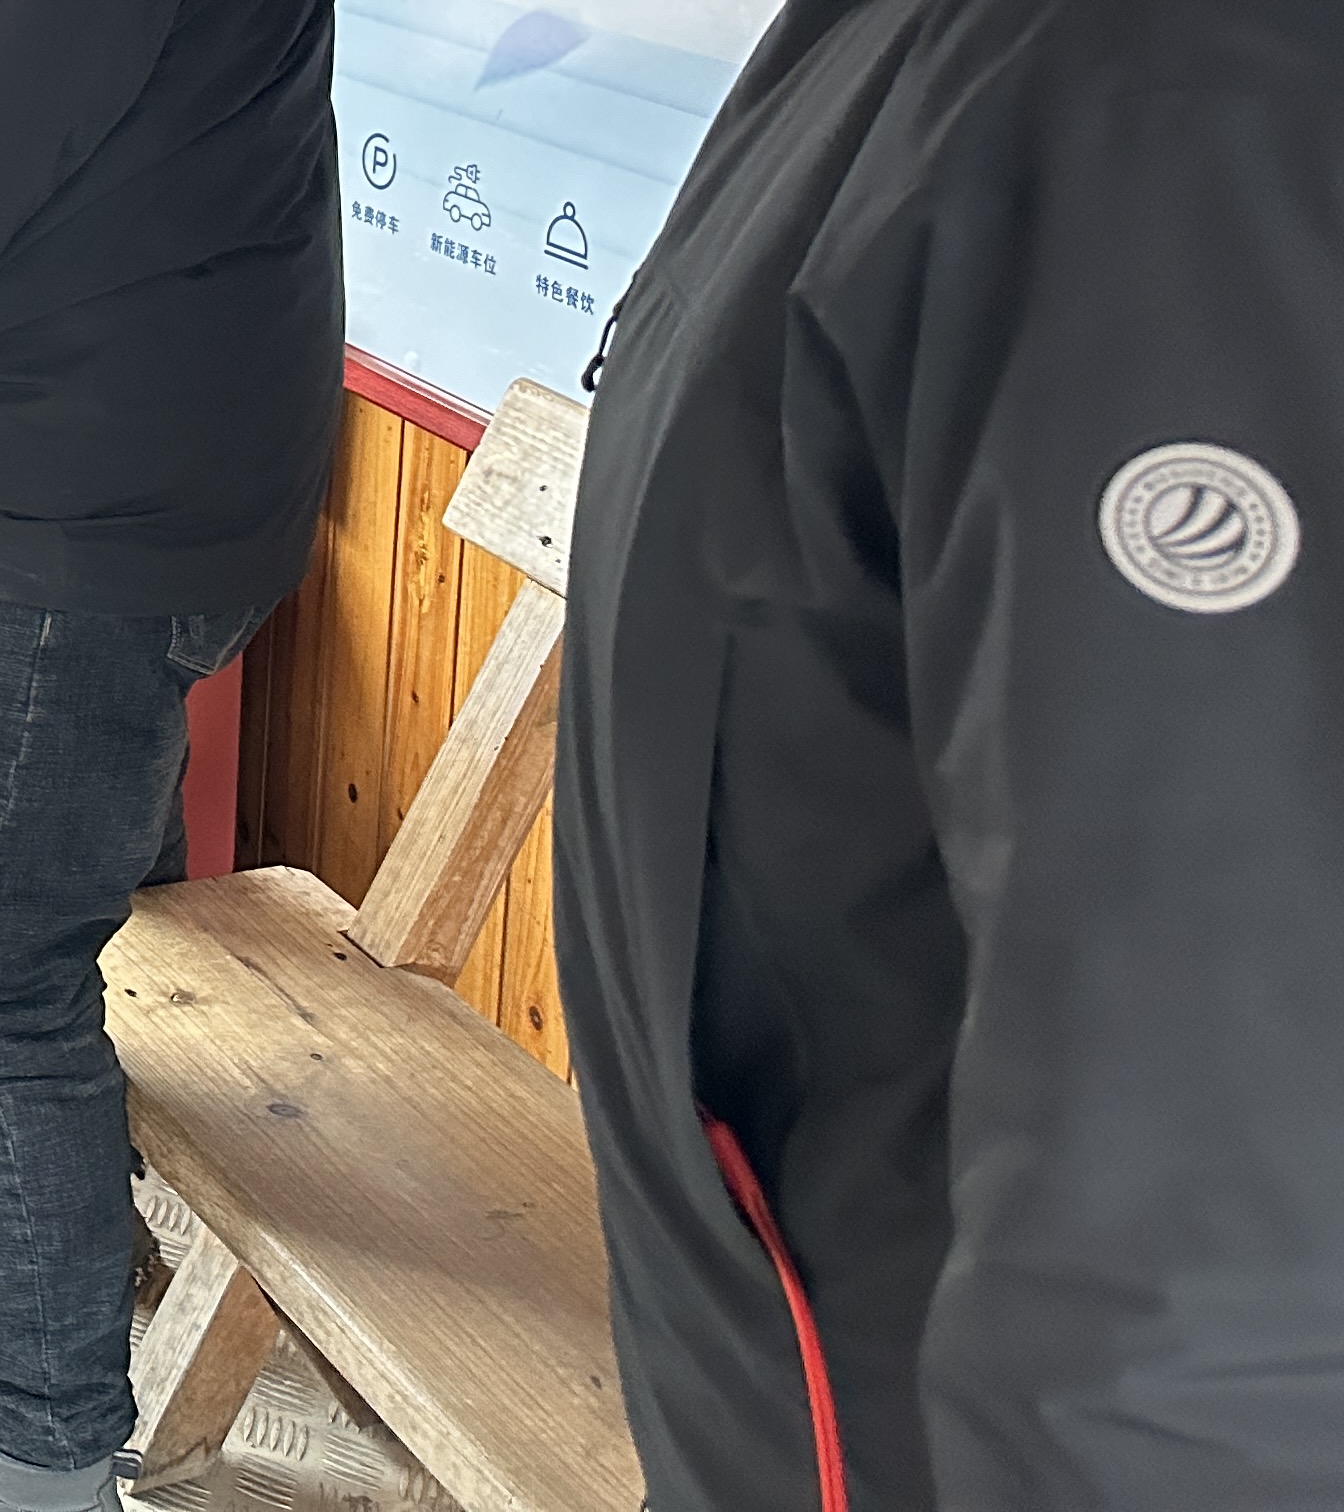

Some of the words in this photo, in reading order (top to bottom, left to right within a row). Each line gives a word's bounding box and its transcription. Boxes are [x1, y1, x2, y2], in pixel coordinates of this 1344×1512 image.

[351, 200, 400, 235] 免费停车
[429, 232, 498, 276] 新能源车位
[535, 273, 595, 316] 特色餐饮
